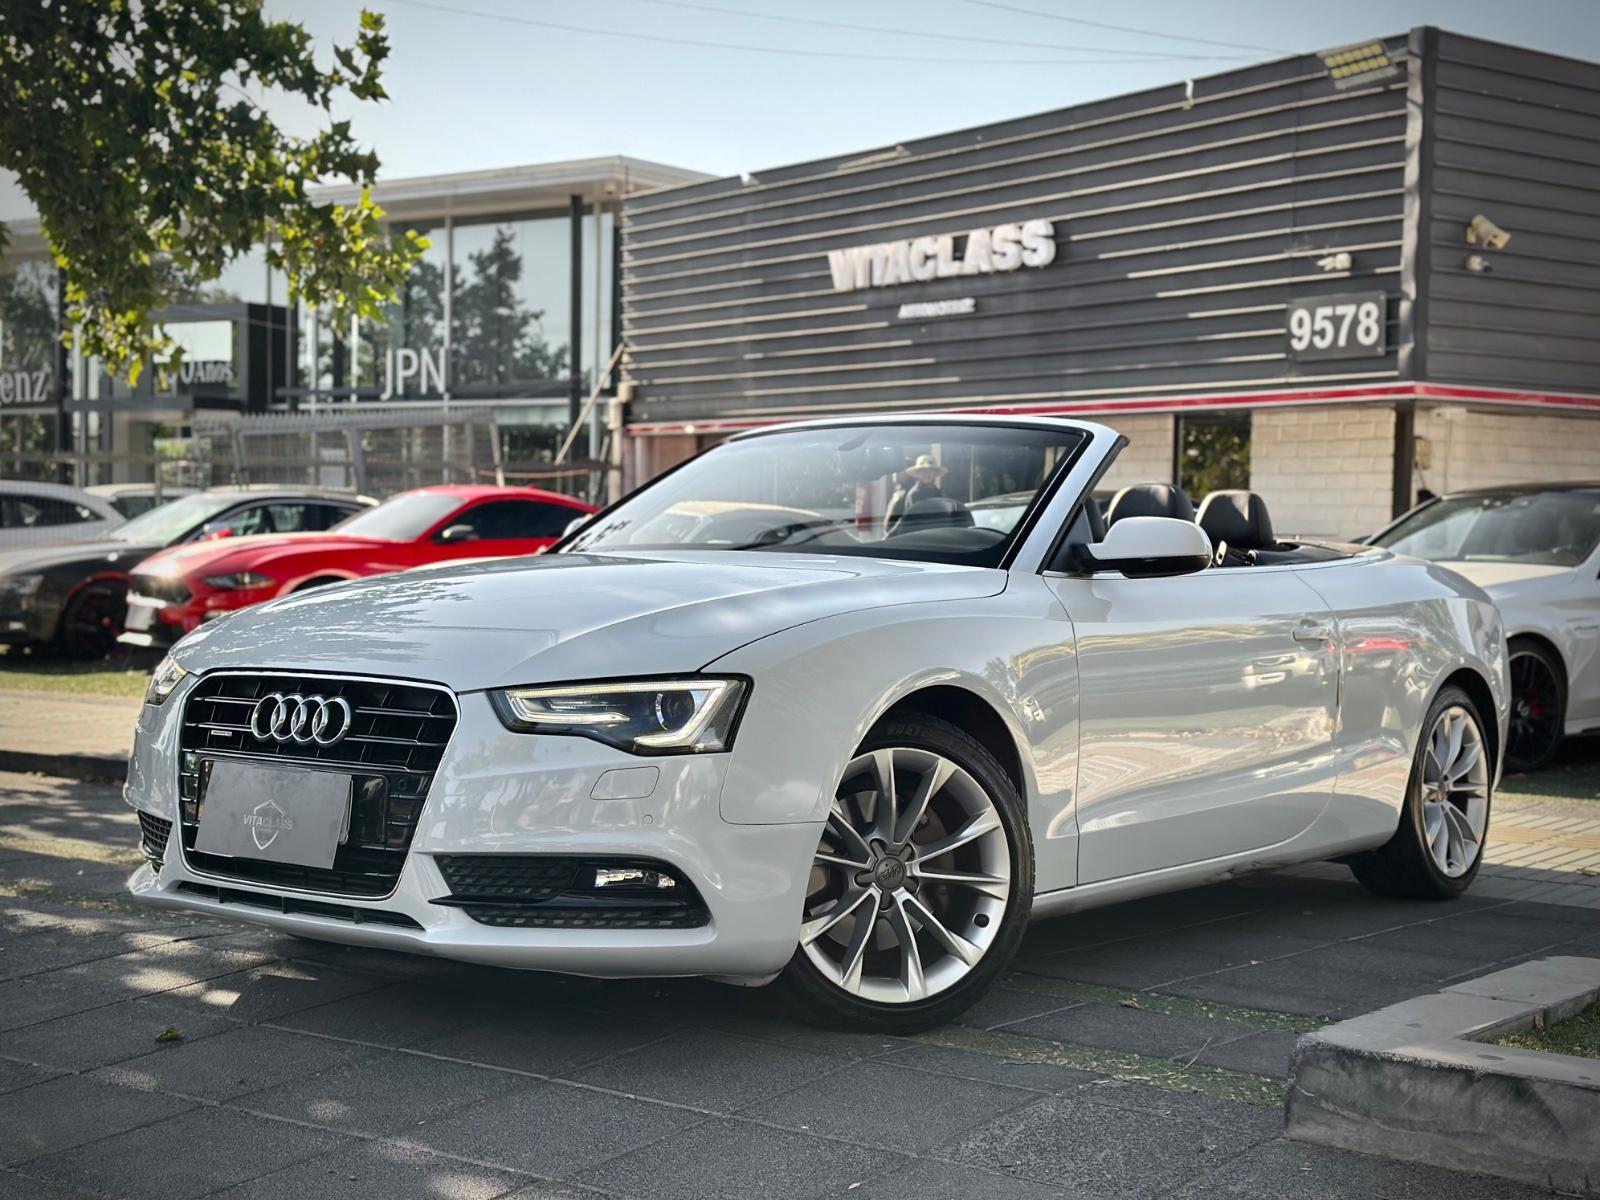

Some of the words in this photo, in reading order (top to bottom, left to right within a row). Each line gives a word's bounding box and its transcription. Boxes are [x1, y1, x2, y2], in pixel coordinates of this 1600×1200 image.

[828, 218, 1056, 290] VITACLASS
[1290, 301, 1380, 351] 9578
[380, 346, 446, 401] JPN
[243, 814, 294, 830] VITACLASS
